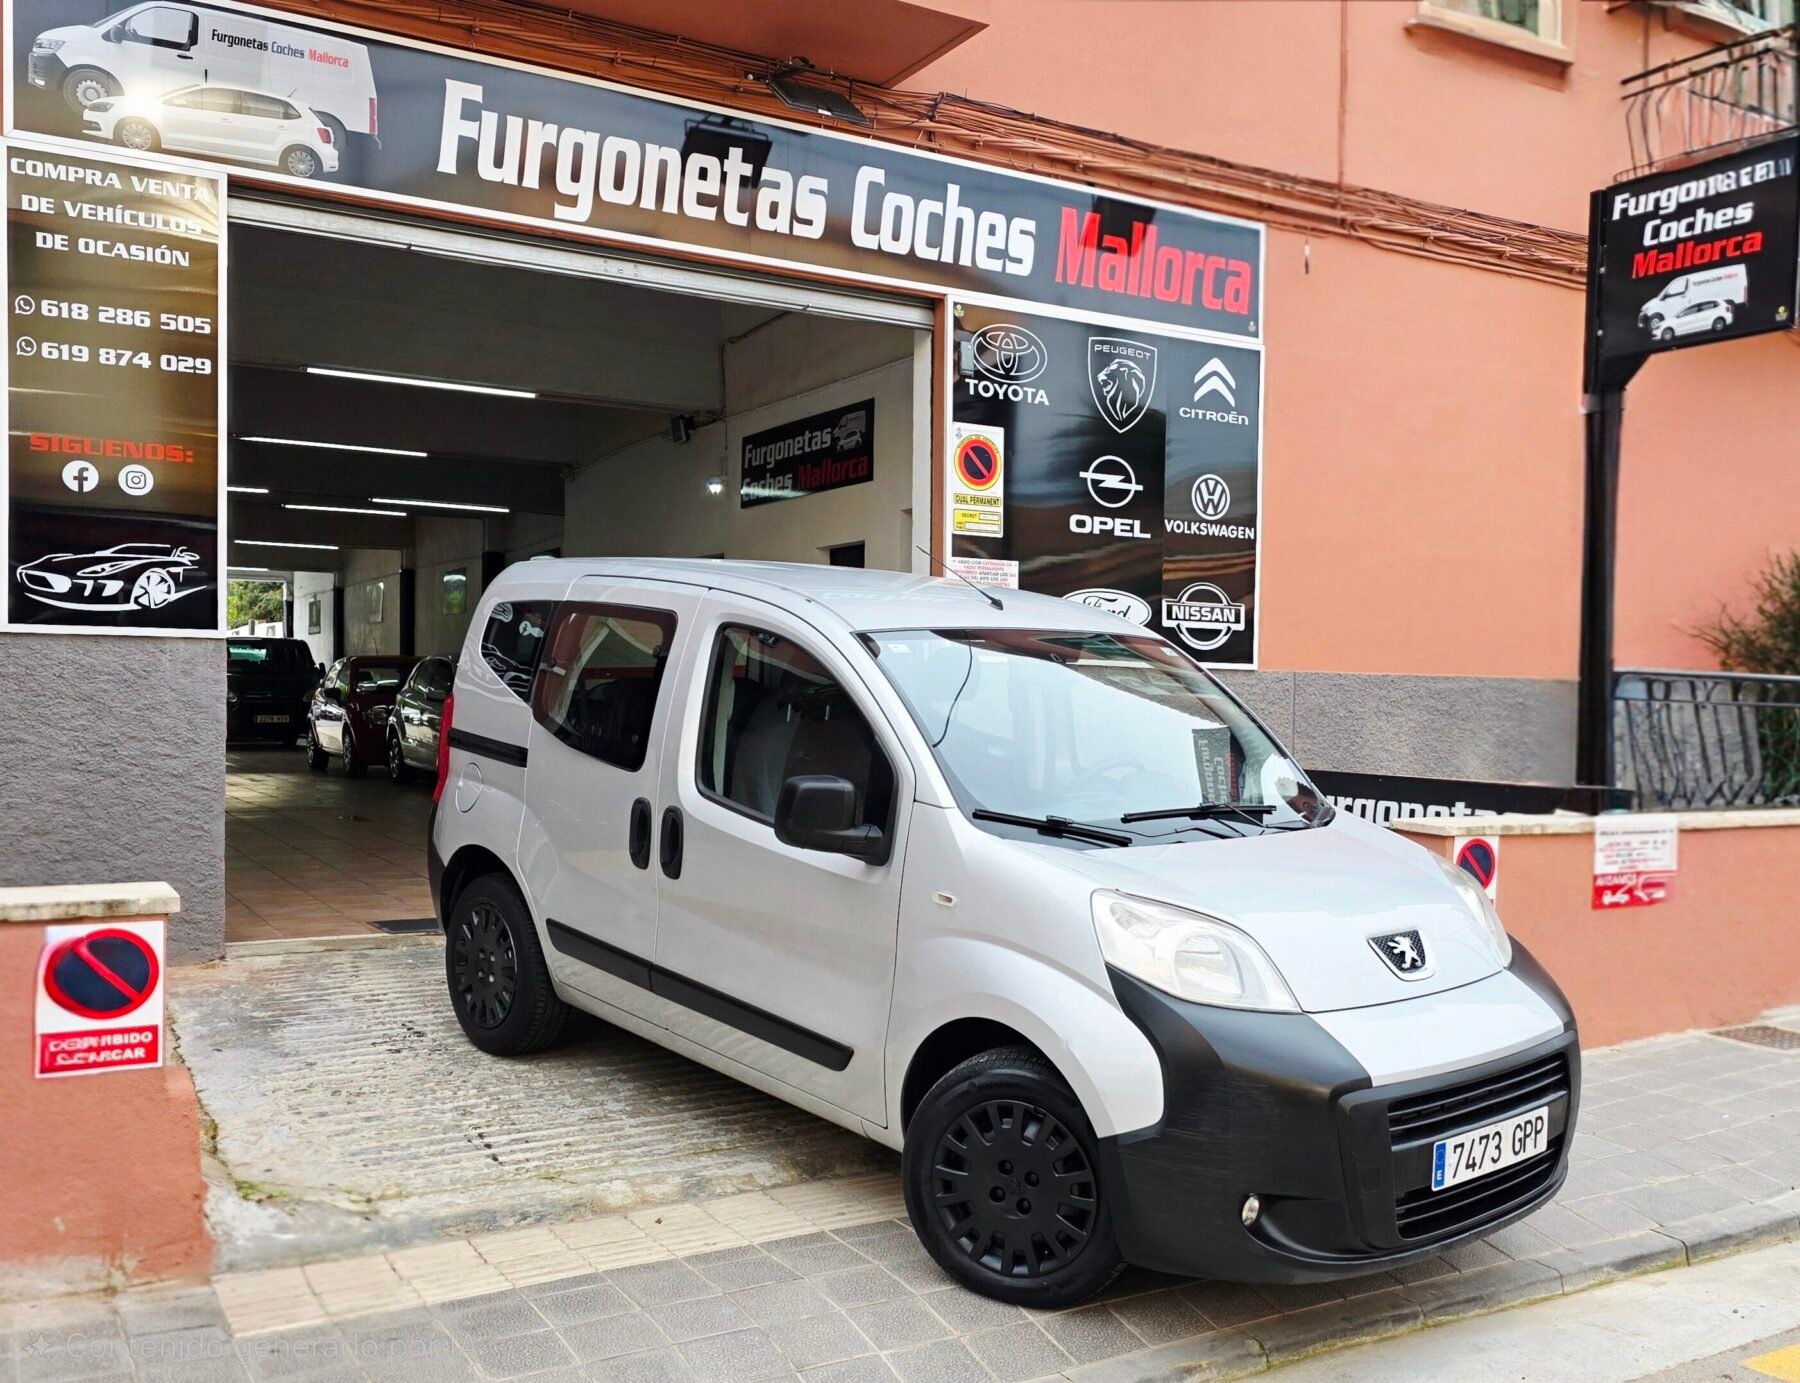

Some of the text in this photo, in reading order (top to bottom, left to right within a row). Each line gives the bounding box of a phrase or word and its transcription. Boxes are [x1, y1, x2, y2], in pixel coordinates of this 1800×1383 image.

[211, 28, 349, 68] Furgonetas Coches Mallorca
[10, 157, 214, 202] COMPRA VENTA
[436, 78, 1253, 314] Furgonetas Coches Mallorca
[21, 194, 203, 234] DE VEHÍCULOS
[1643, 201, 1755, 247] Coches
[35, 231, 190, 267] DE OCASIÓN
[1632, 231, 1763, 278] Mallorca
[41, 299, 212, 335] 618 286 505
[41, 341, 212, 375] 619 874 029
[1094, 344, 1151, 360] PEUGEOT
[964, 378, 1050, 406] TOYOTA
[744, 427, 832, 469] Furgonetas
[742, 455, 869, 501] Coches Mallorca
[970, 496, 1000, 506] PERMANENT
[1069, 514, 1151, 539] OPEL
[1164, 519, 1255, 540] VOLKSWAGEN
[1172, 605, 1236, 622] NISSAN
[1452, 1115, 1544, 1179] 7473 GPP
[1436, 1169, 1443, 1181] E
